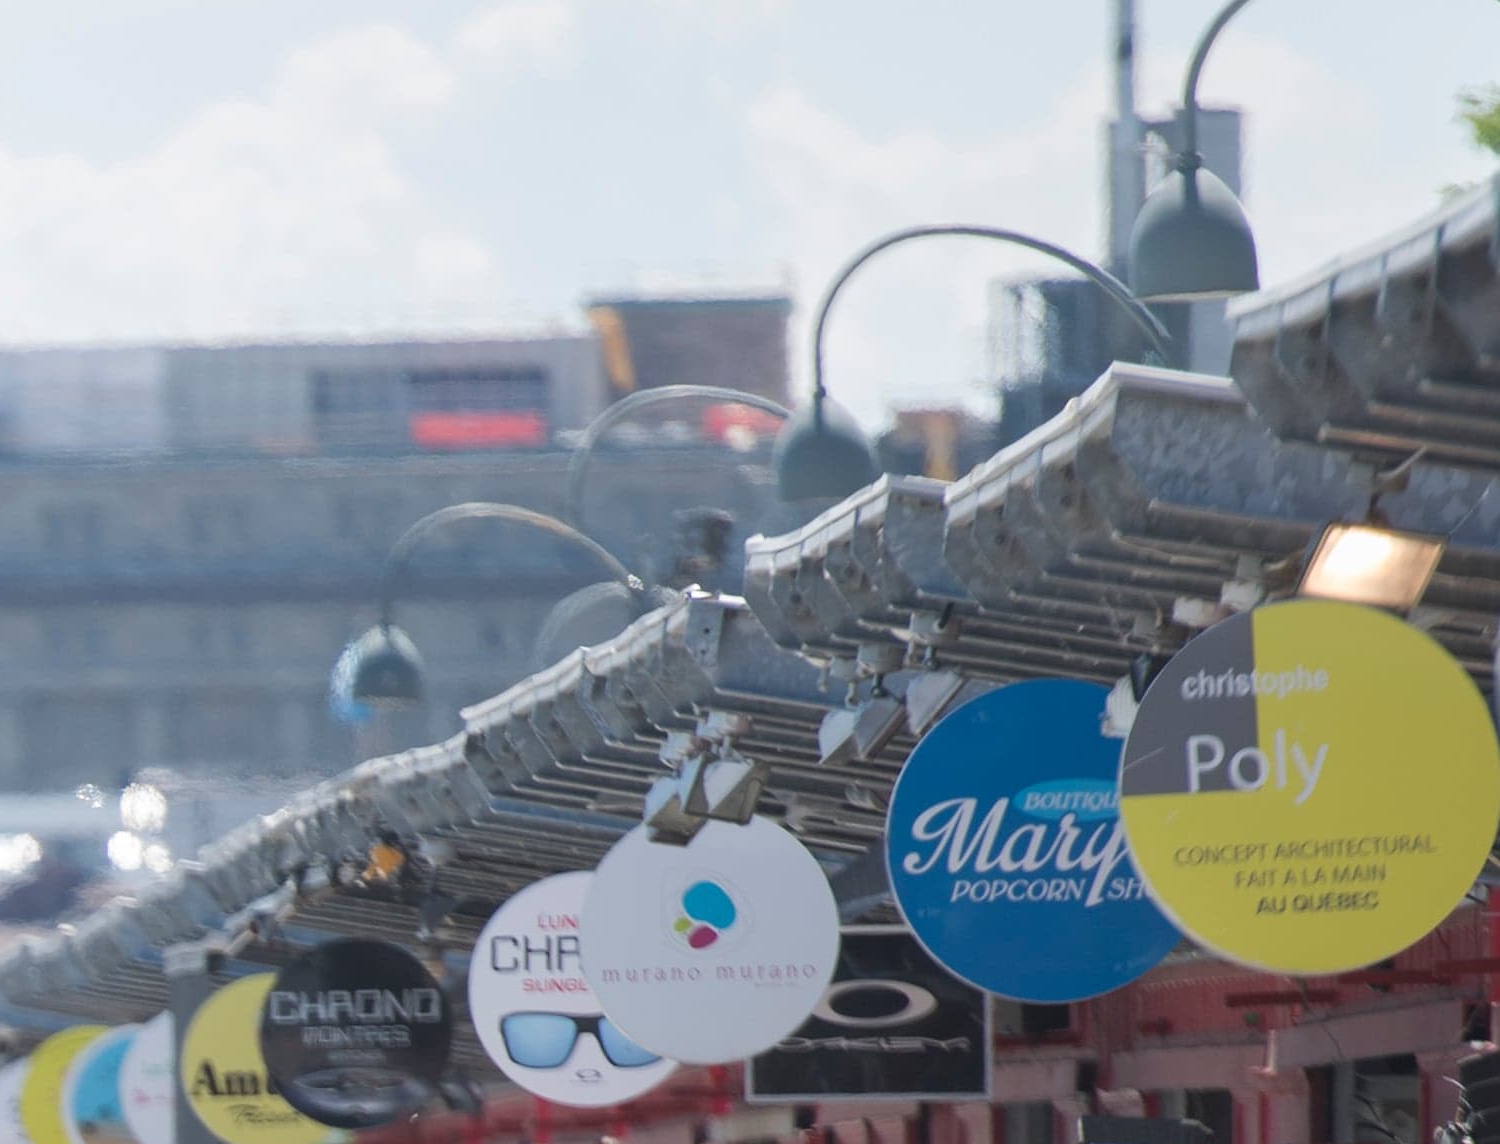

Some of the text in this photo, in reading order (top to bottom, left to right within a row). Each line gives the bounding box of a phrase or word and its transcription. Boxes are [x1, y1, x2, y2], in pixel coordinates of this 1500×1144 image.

[1182, 665, 1329, 700] christophe
[1186, 727, 1329, 805] Poly
[1022, 791, 1117, 811] BOUTIQU
[903, 797, 1129, 908] Mary
[1173, 833, 1437, 867] CONCEPT ARCHITECTURAL
[1234, 867, 1278, 889] FAIT
[1302, 865, 1328, 886] LA
[1331, 863, 1388, 884] MAIN
[951, 877, 1150, 902] POPCORN SH
[1256, 895, 1287, 914] AU
[537, 913, 580, 930] LUN
[490, 935, 581, 973] CHR
[522, 977, 588, 993] SUNGL
[601, 964, 817, 983] murano murano
[270, 987, 442, 1024] CHRONO
